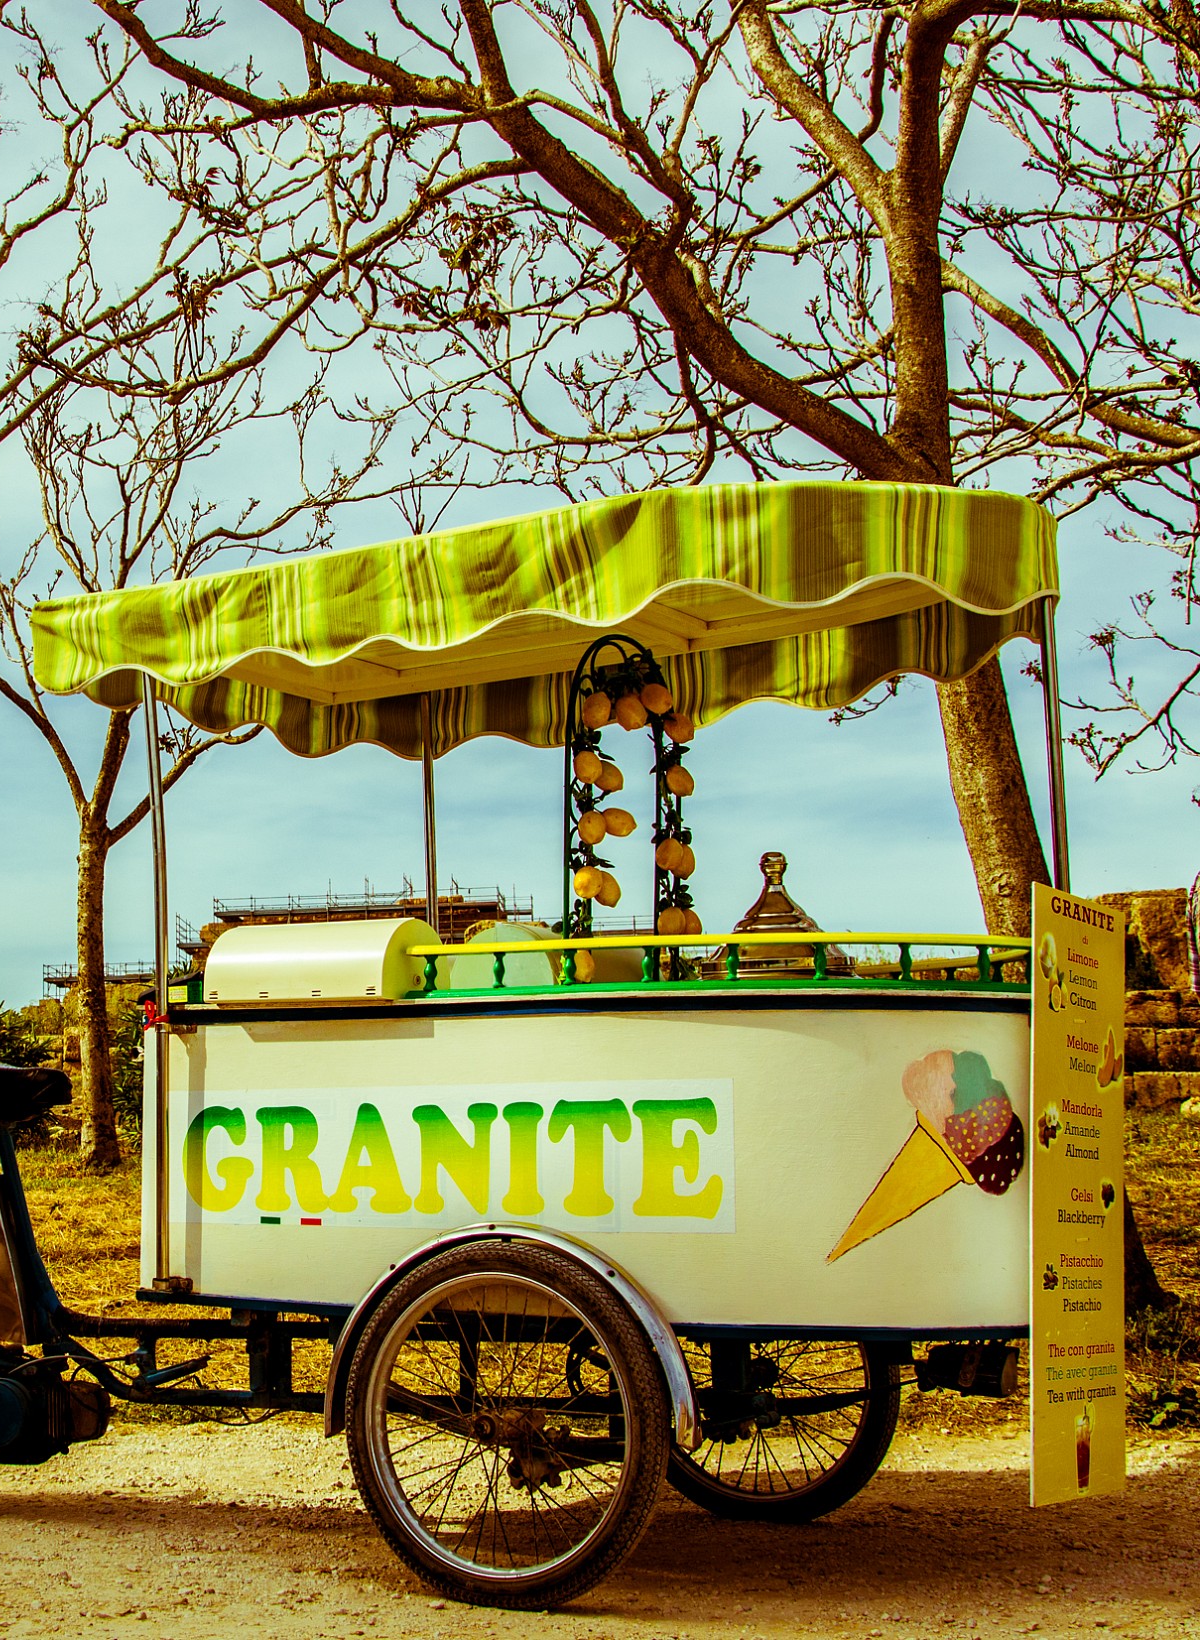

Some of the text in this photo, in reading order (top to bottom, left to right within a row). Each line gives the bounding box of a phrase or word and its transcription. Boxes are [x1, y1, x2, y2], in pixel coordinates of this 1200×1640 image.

[1051, 896, 1114, 932] GRANITE
[1082, 935, 1089, 946] di
[1067, 947, 1099, 969] Limone
[1069, 969, 1098, 990] Lemon
[1069, 991, 1097, 1011] Citron
[1066, 1034, 1099, 1053] Melone
[1069, 1056, 1097, 1075] Melon
[1061, 1099, 1103, 1118] Mandorla
[1064, 1121, 1100, 1139] Amande
[183, 1096, 723, 1220] GRANITE
[1065, 1143, 1099, 1160] Almond
[1070, 1187, 1094, 1203] Gelsi
[1057, 1209, 1106, 1228] Blackberry
[1059, 1253, 1104, 1268] Pistacchio
[1061, 1276, 1103, 1290] Pistaches
[1063, 1298, 1102, 1312] Pistachio
[1048, 1340, 1115, 1358] The con granita
[1066, 1366, 1087, 1379] avec
[1088, 1363, 1118, 1380] granita
[1047, 1383, 1117, 1403] Tea with granita
